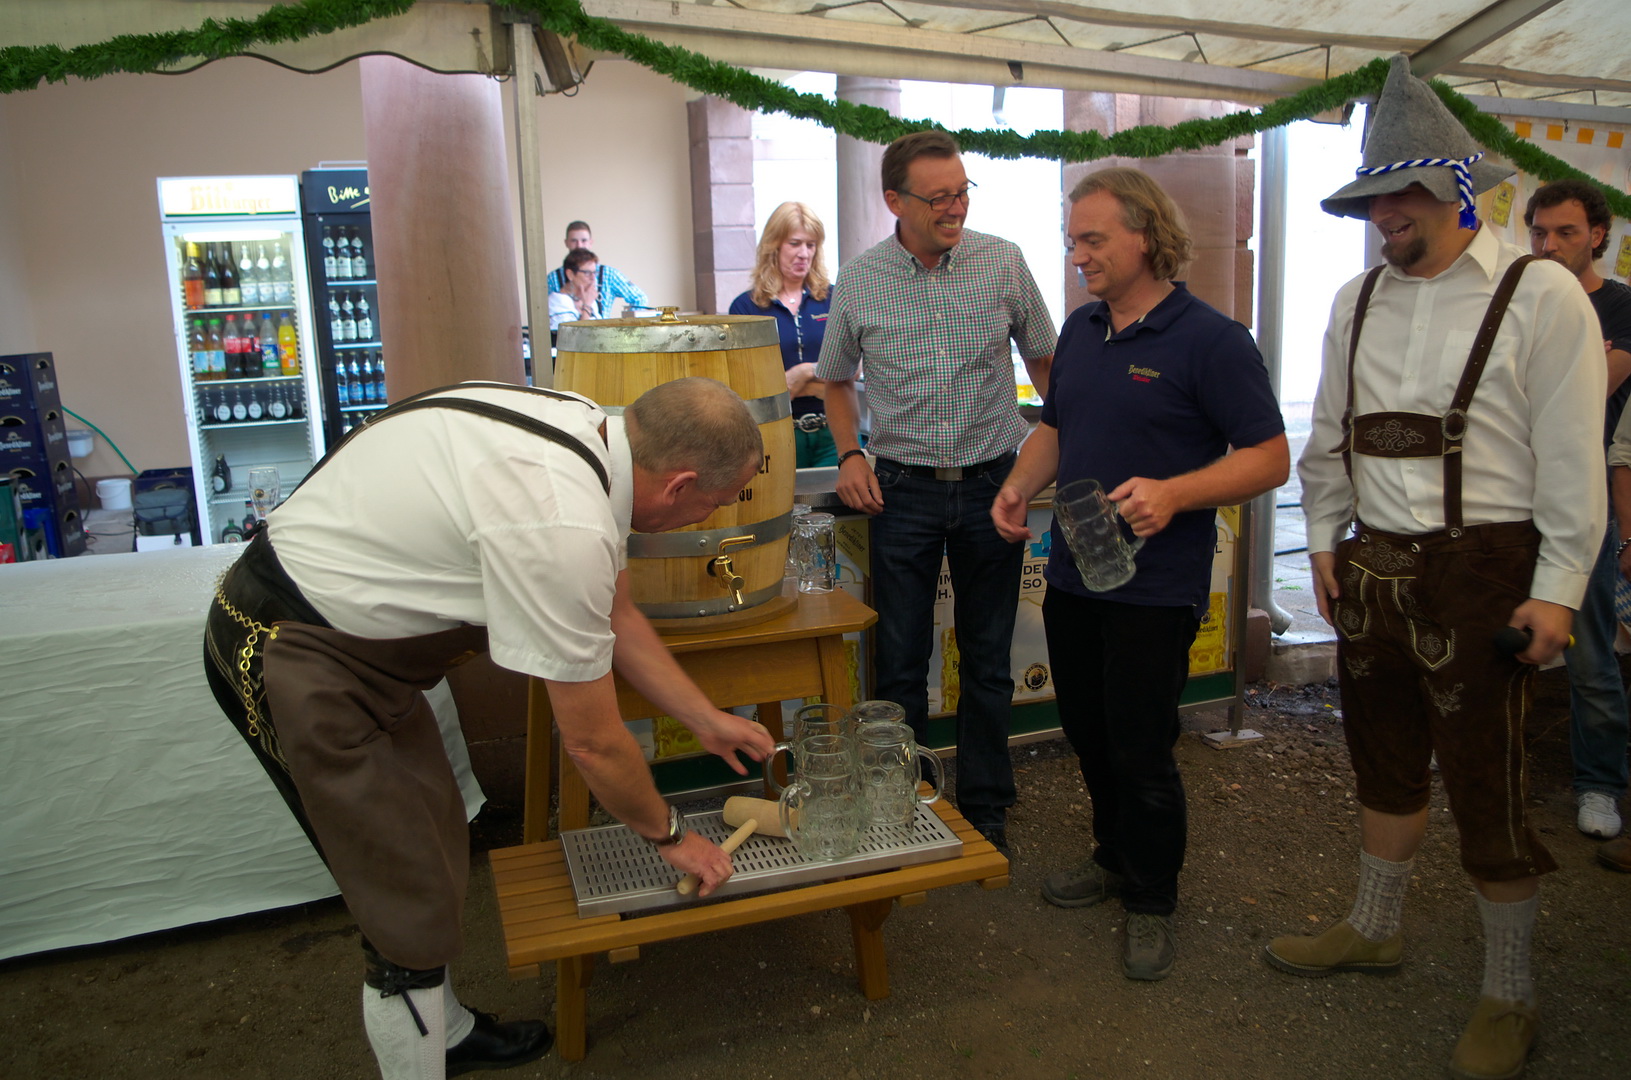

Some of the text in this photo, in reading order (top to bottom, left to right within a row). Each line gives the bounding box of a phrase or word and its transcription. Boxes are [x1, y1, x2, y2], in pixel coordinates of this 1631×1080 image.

[190, 185, 273, 214] Bitburger
[327, 185, 361, 204] Bitte
[1022, 578, 1042, 590] SO
